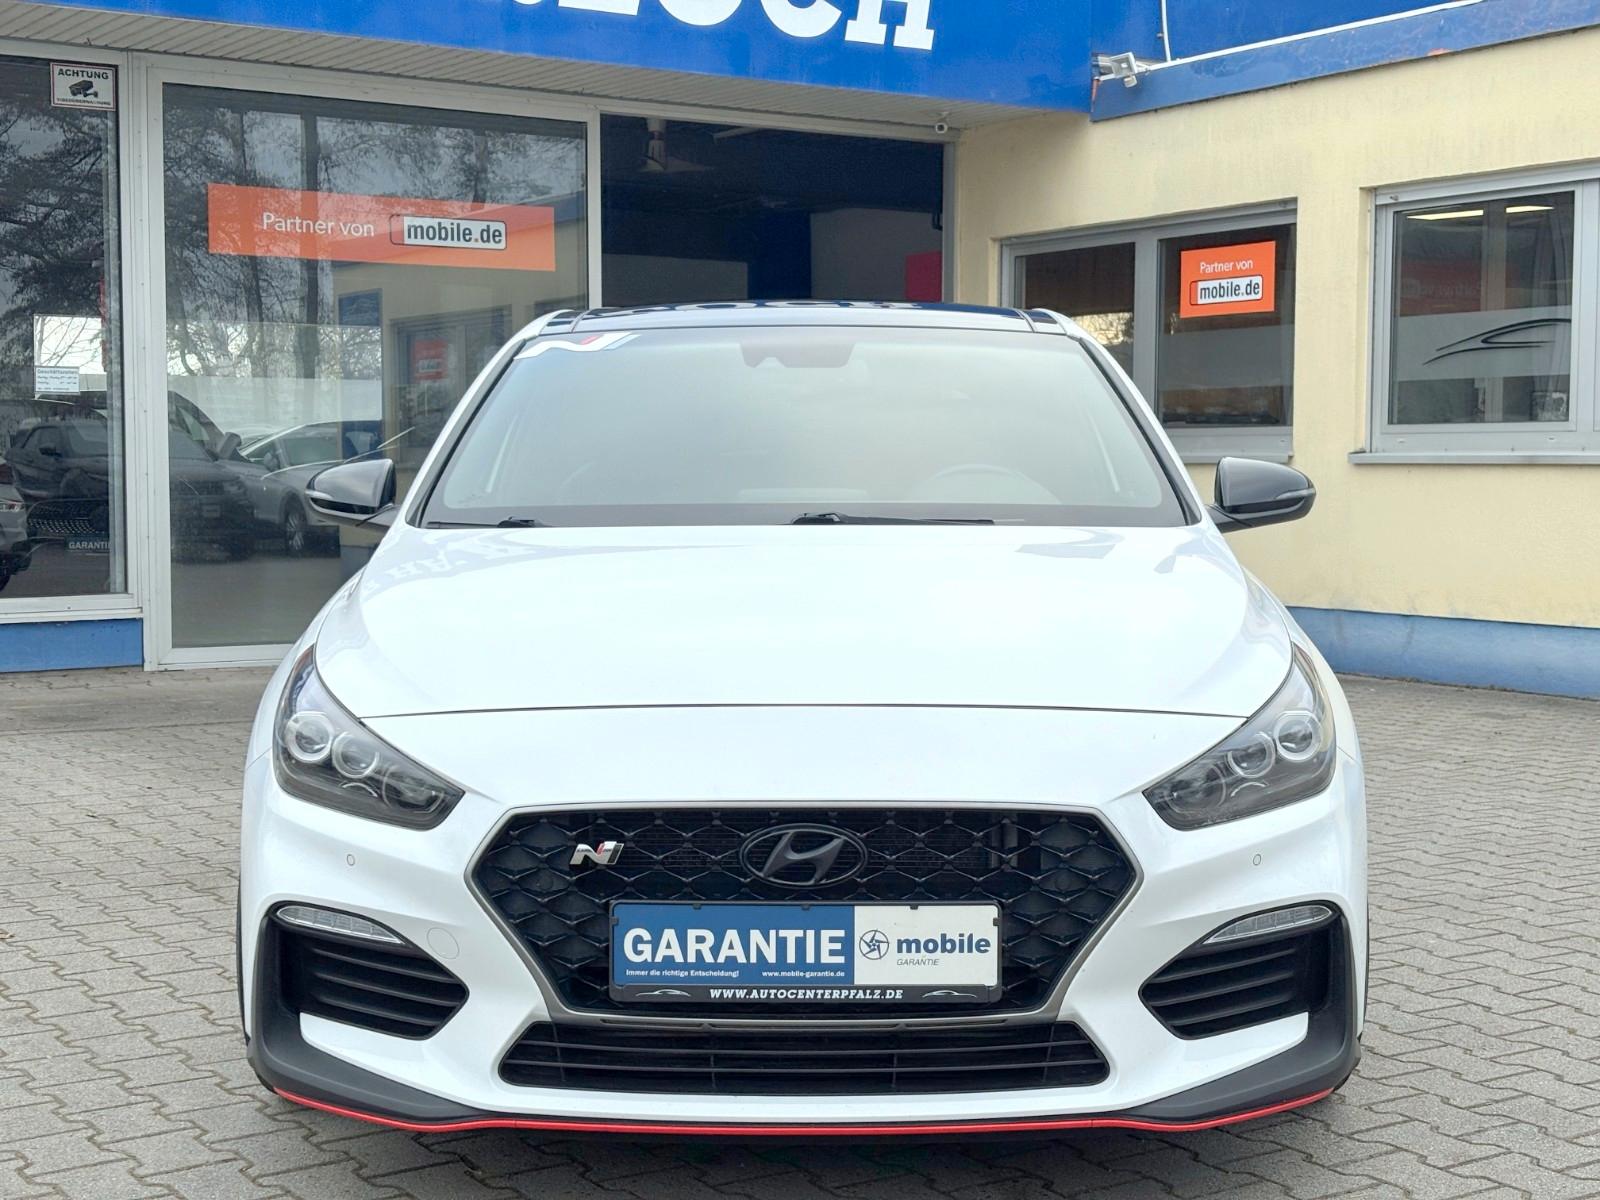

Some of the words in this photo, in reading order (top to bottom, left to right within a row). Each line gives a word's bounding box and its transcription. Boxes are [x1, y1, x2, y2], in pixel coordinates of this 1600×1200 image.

[57, 68, 109, 80] ACHTUNG
[262, 212, 335, 235] Partner
[340, 223, 375, 237] von
[406, 222, 503, 244] mobile.de
[1200, 261, 1234, 274] Partner
[1235, 259, 1254, 271] von
[1200, 279, 1260, 300] mobile.de
[623, 927, 846, 964] GARANTIE
[896, 933, 991, 954] mobile
[896, 958, 940, 966] GARANTIE
[626, 968, 648, 976] Immer
[649, 968, 661, 976] die
[662, 969, 689, 978] richtige
[690, 969, 739, 978] Entscheidung!
[762, 970, 845, 978] www.mobile-garantie.de
[709, 988, 904, 999] WWW.AUTOCENTERPFALZ.DE
